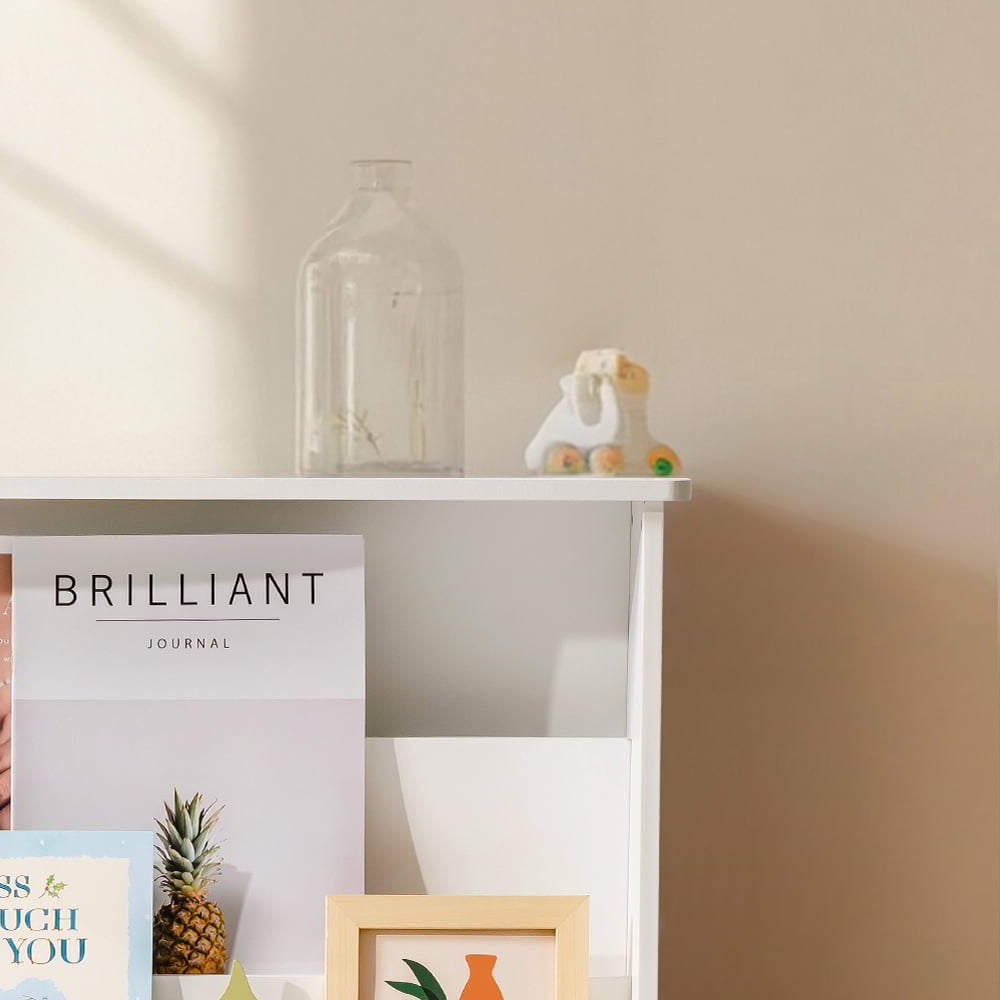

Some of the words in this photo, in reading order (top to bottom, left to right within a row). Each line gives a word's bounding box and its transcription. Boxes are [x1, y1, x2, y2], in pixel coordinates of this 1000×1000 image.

[54, 573, 324, 606] BRILLIANT
[147, 638, 230, 650] JOURNAL
[2, 937, 88, 965] YOU
